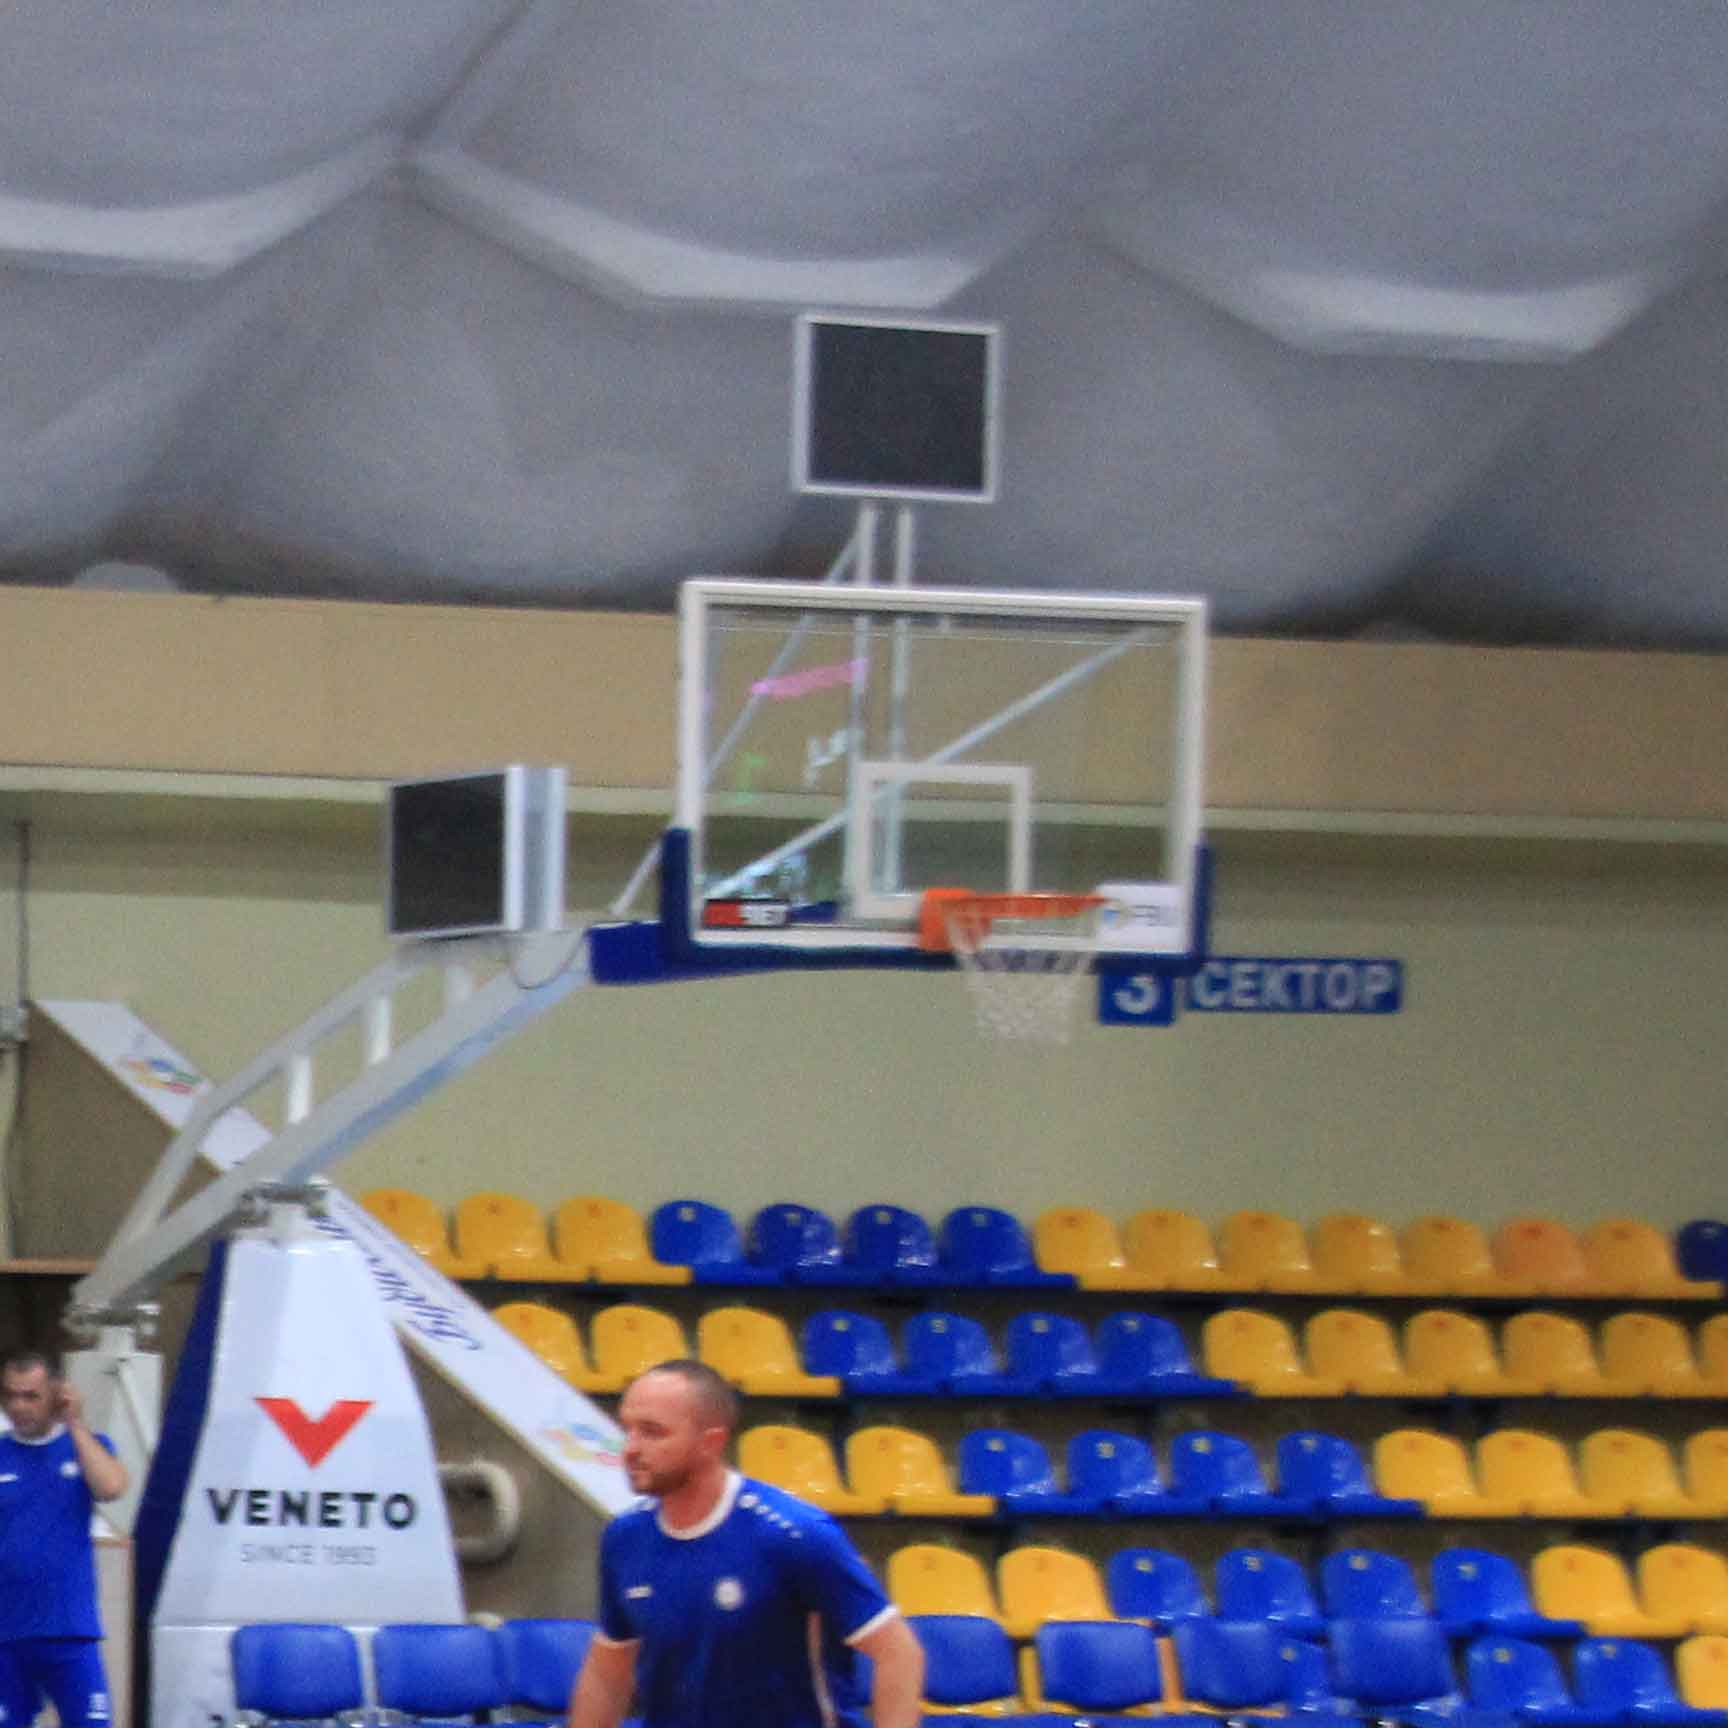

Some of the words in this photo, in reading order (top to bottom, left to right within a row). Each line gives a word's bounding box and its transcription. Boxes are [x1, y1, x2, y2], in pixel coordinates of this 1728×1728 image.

[1192, 960, 1396, 1010] СЕКТОР
[206, 1487, 419, 1531] VENETO
[241, 1543, 313, 1564] SINCE
